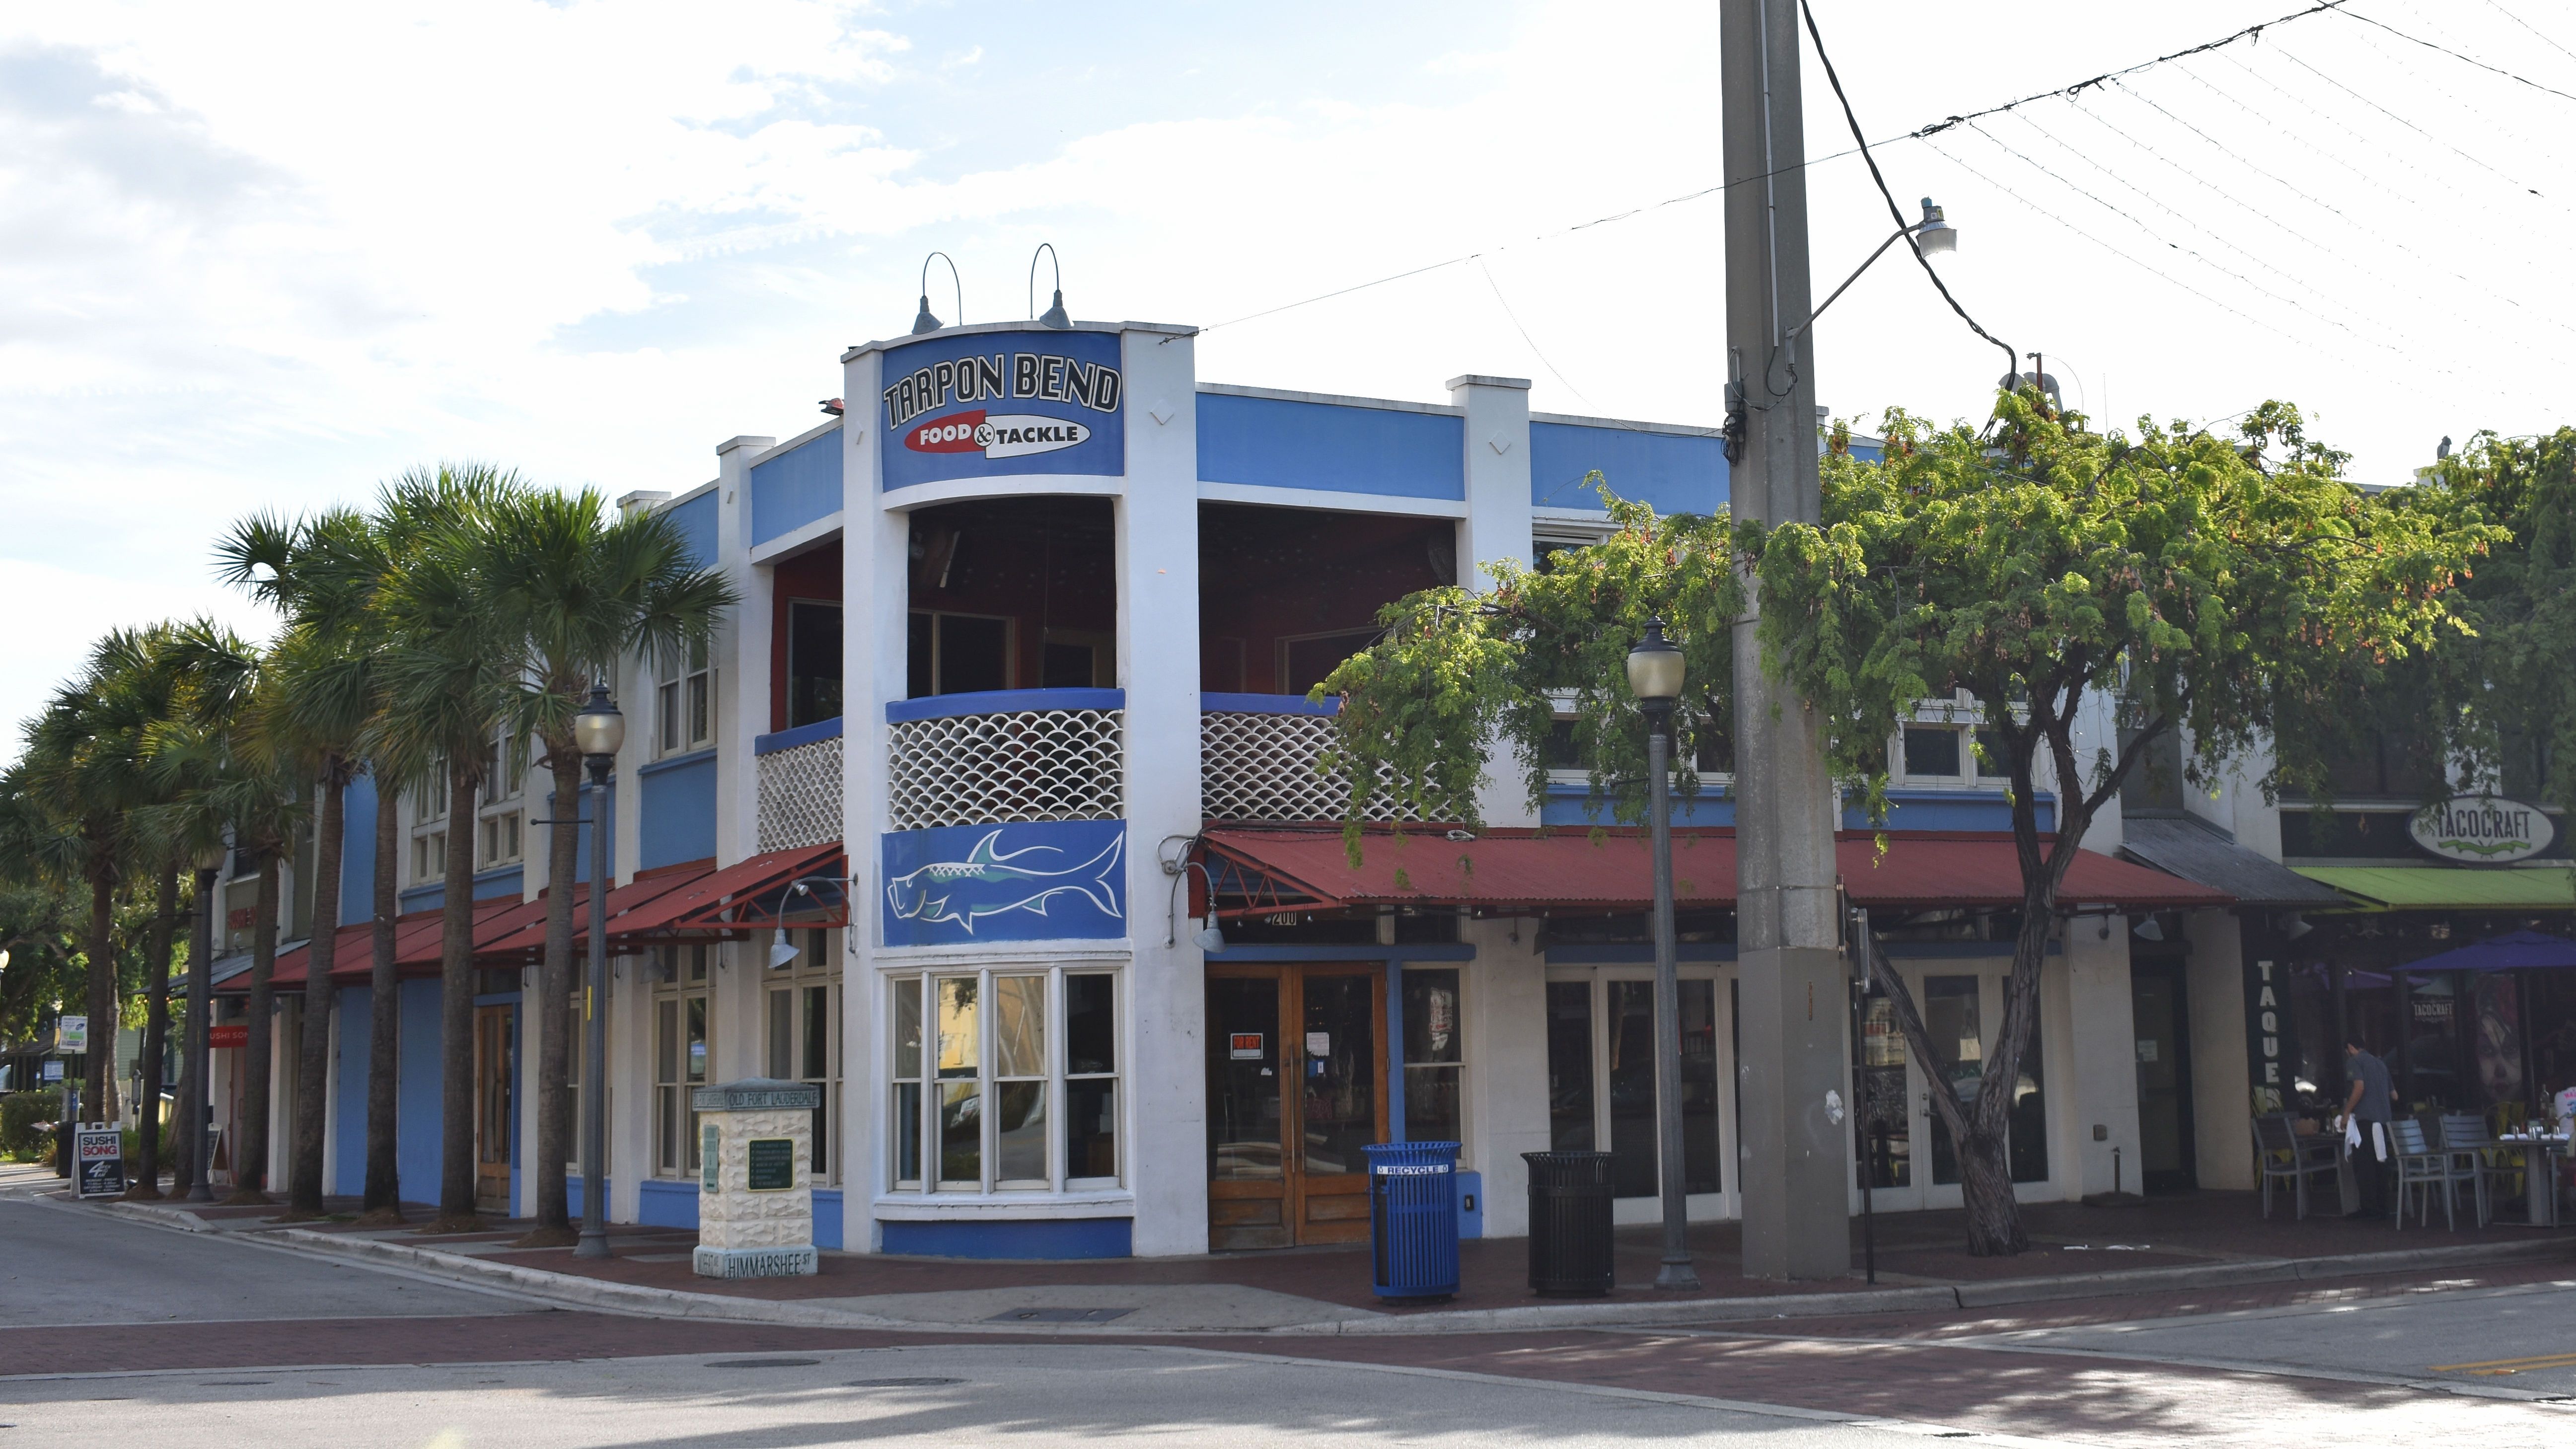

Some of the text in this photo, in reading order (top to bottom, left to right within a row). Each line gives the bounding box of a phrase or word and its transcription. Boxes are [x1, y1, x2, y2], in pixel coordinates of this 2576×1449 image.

[883, 353, 1121, 431] TARPON BEND
[920, 424, 1078, 445] FOOD & TACKLE
[2437, 808, 2530, 838] TACOCRAFT
[2415, 1004, 2452, 1016] TACOCRAFT
[1234, 1035, 1259, 1049] FOR RENT
[729, 1094, 744, 1106] OLD
[747, 1093, 767, 1105] FORT
[771, 1091, 817, 1105] LAUDERDALE
[83, 1136, 116, 1145] SUSHI
[83, 1145, 117, 1156] SONG
[728, 1253, 811, 1279] HIMMARSHEE ST
